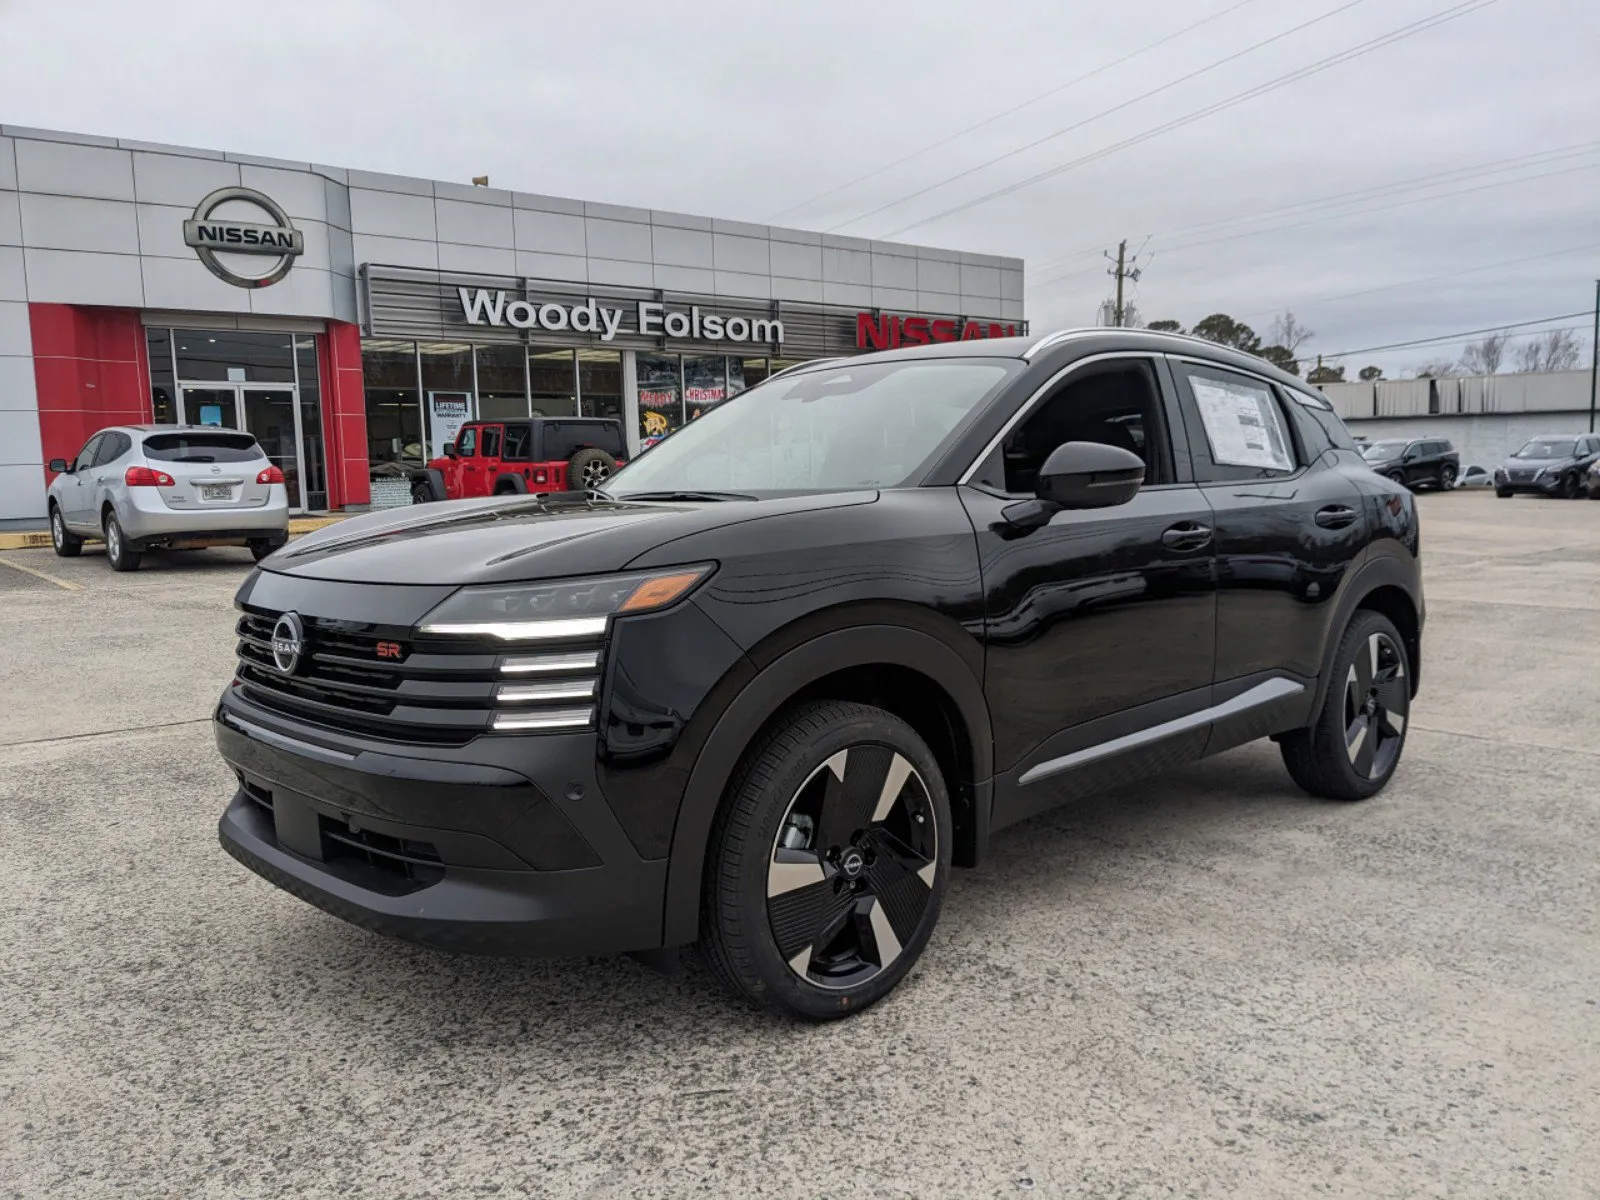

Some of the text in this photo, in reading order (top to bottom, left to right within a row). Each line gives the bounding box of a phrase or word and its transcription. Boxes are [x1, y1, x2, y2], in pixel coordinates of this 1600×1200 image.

[198, 225, 293, 248] NISSAN
[458, 287, 785, 343] Woody Folsom
[376, 641, 401, 657] SR
